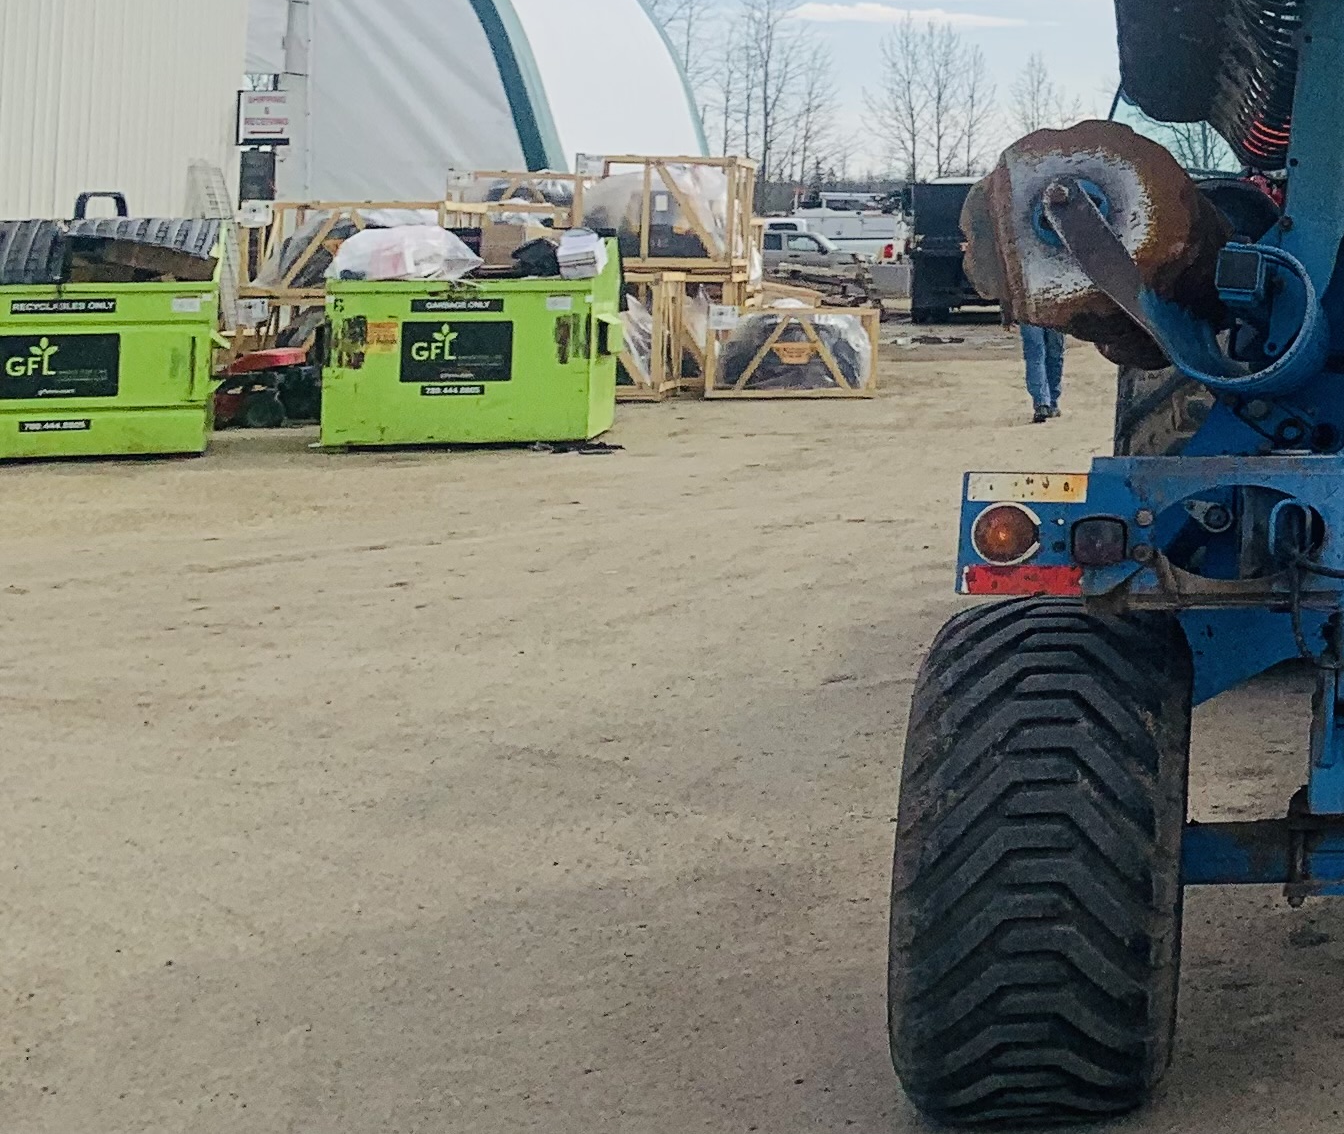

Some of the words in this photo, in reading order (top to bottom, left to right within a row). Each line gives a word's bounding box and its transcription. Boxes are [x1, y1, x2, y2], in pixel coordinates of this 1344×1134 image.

[87, 300, 115, 311] ONLY
[466, 300, 490, 309] ONLY
[411, 333, 457, 361] GFL
[5, 346, 57, 377] GFL
